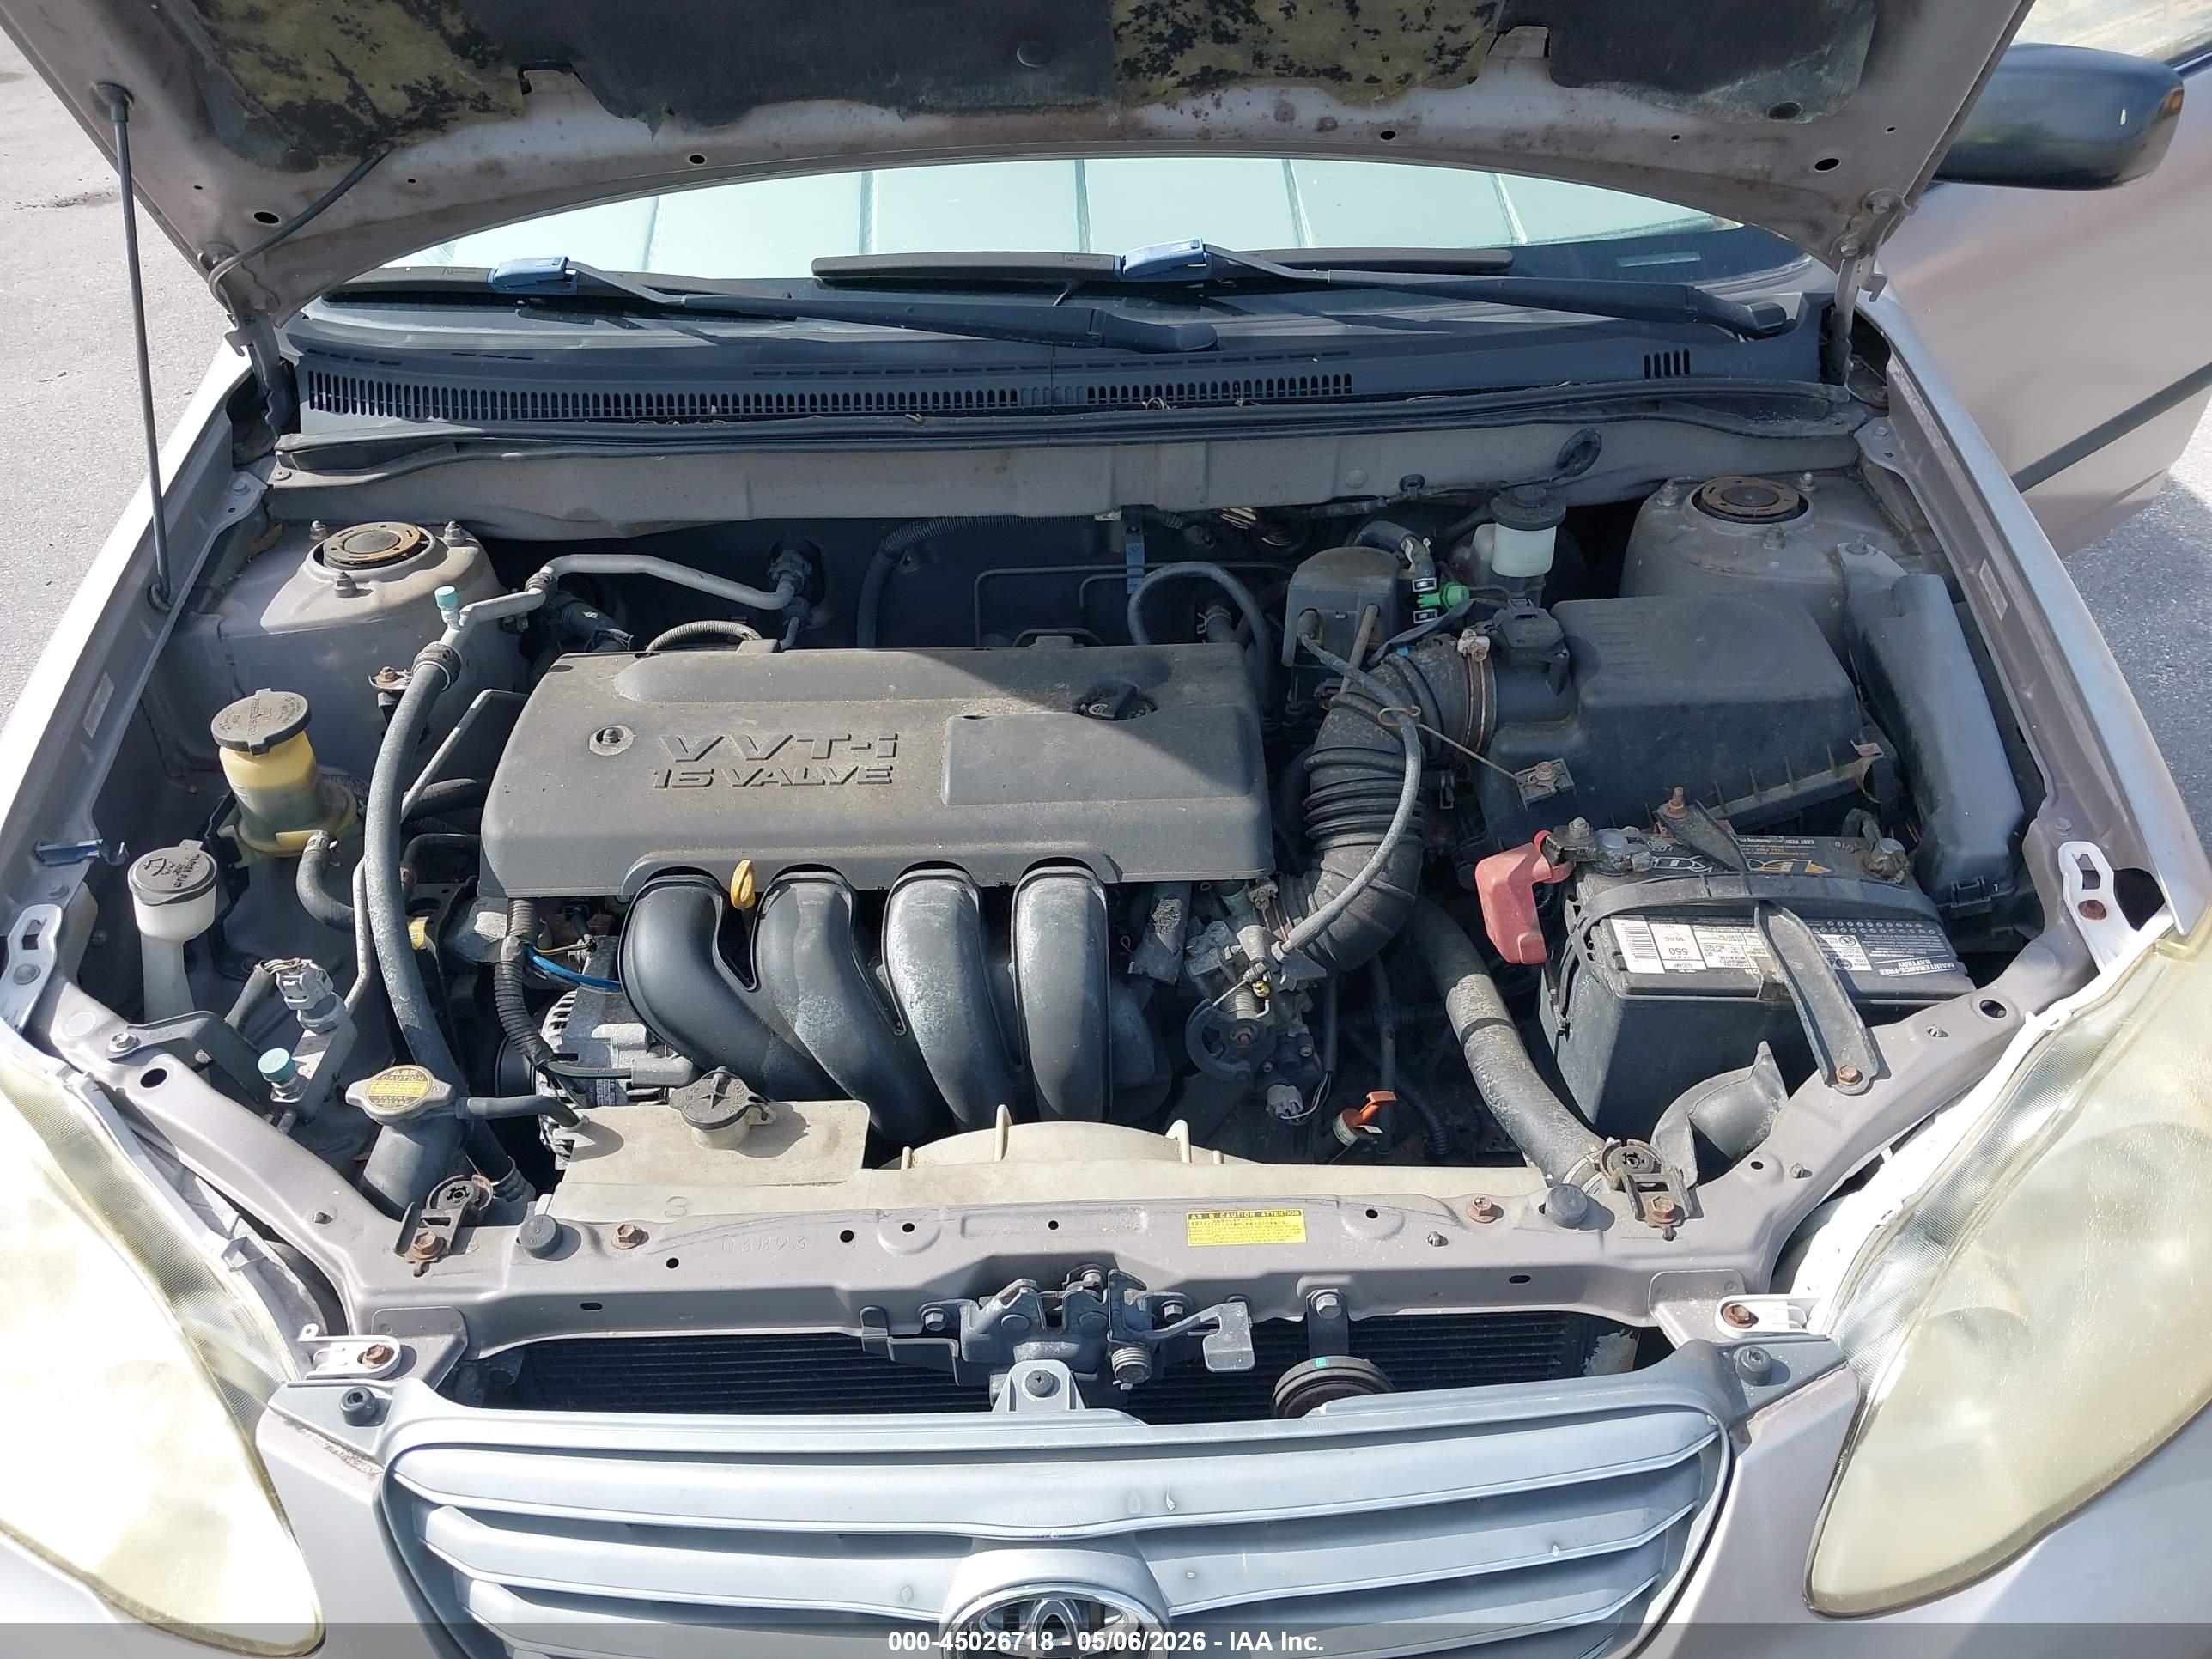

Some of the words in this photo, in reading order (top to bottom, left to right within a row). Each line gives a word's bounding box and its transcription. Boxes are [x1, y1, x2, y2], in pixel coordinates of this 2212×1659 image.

[653, 768, 715, 789] 16
[721, 765, 894, 787] VALVE
[1878, 962, 1955, 975] MAINTENANCE-FREE
[1897, 959, 1931, 968] BATTERY
[664, 1195, 690, 1218] 3
